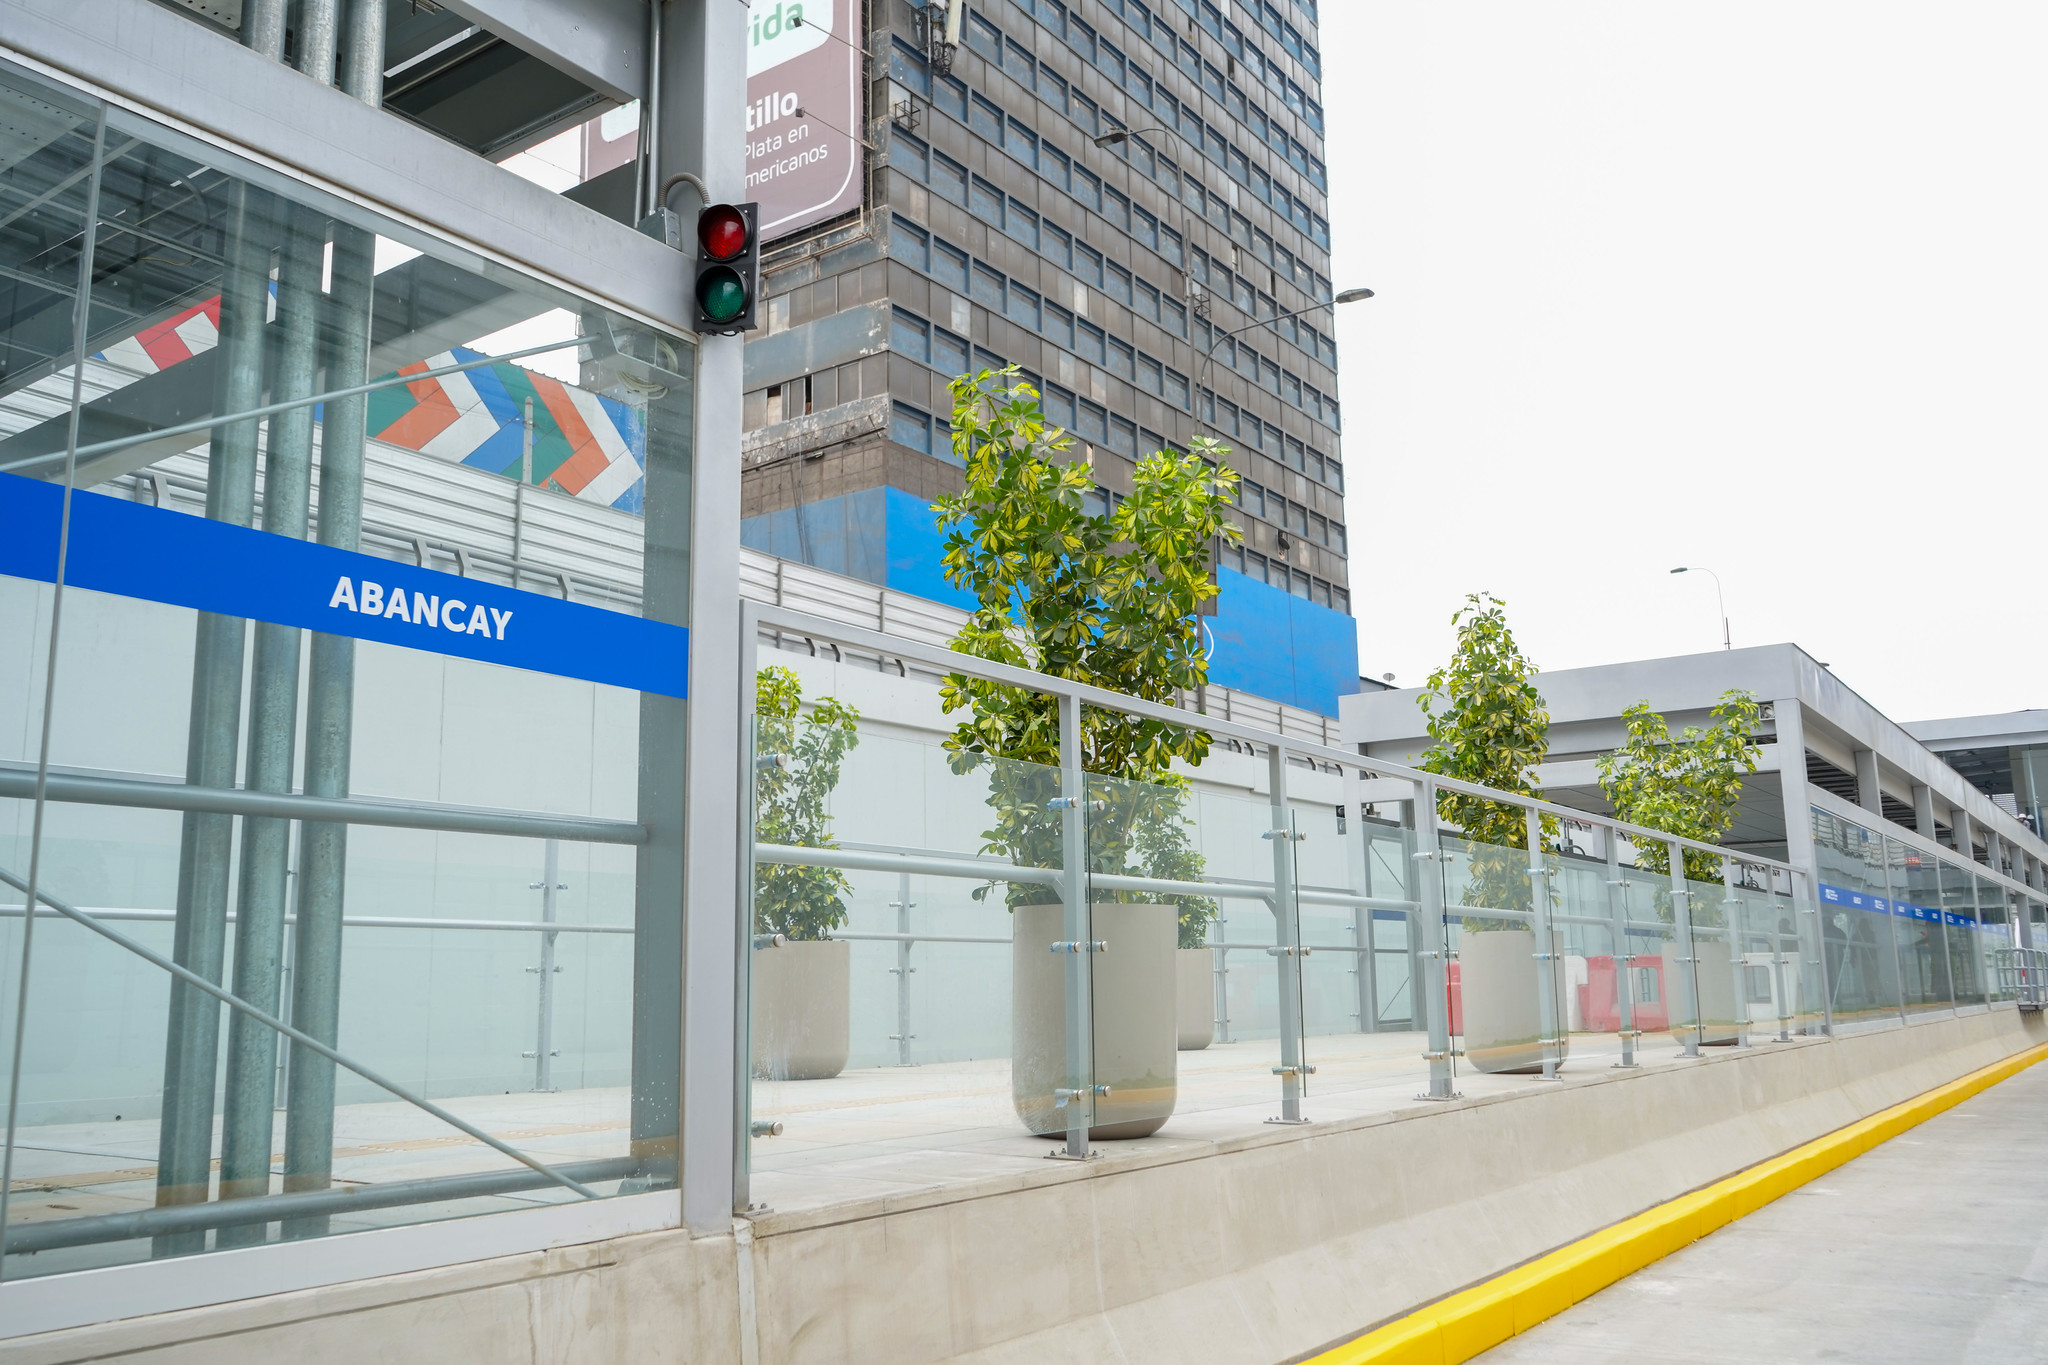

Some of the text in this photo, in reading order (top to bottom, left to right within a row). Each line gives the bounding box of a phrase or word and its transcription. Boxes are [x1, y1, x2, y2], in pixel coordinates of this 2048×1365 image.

[748, 2, 803, 47] ida
[788, 124, 809, 143] en
[329, 576, 514, 641] ABANCAY
